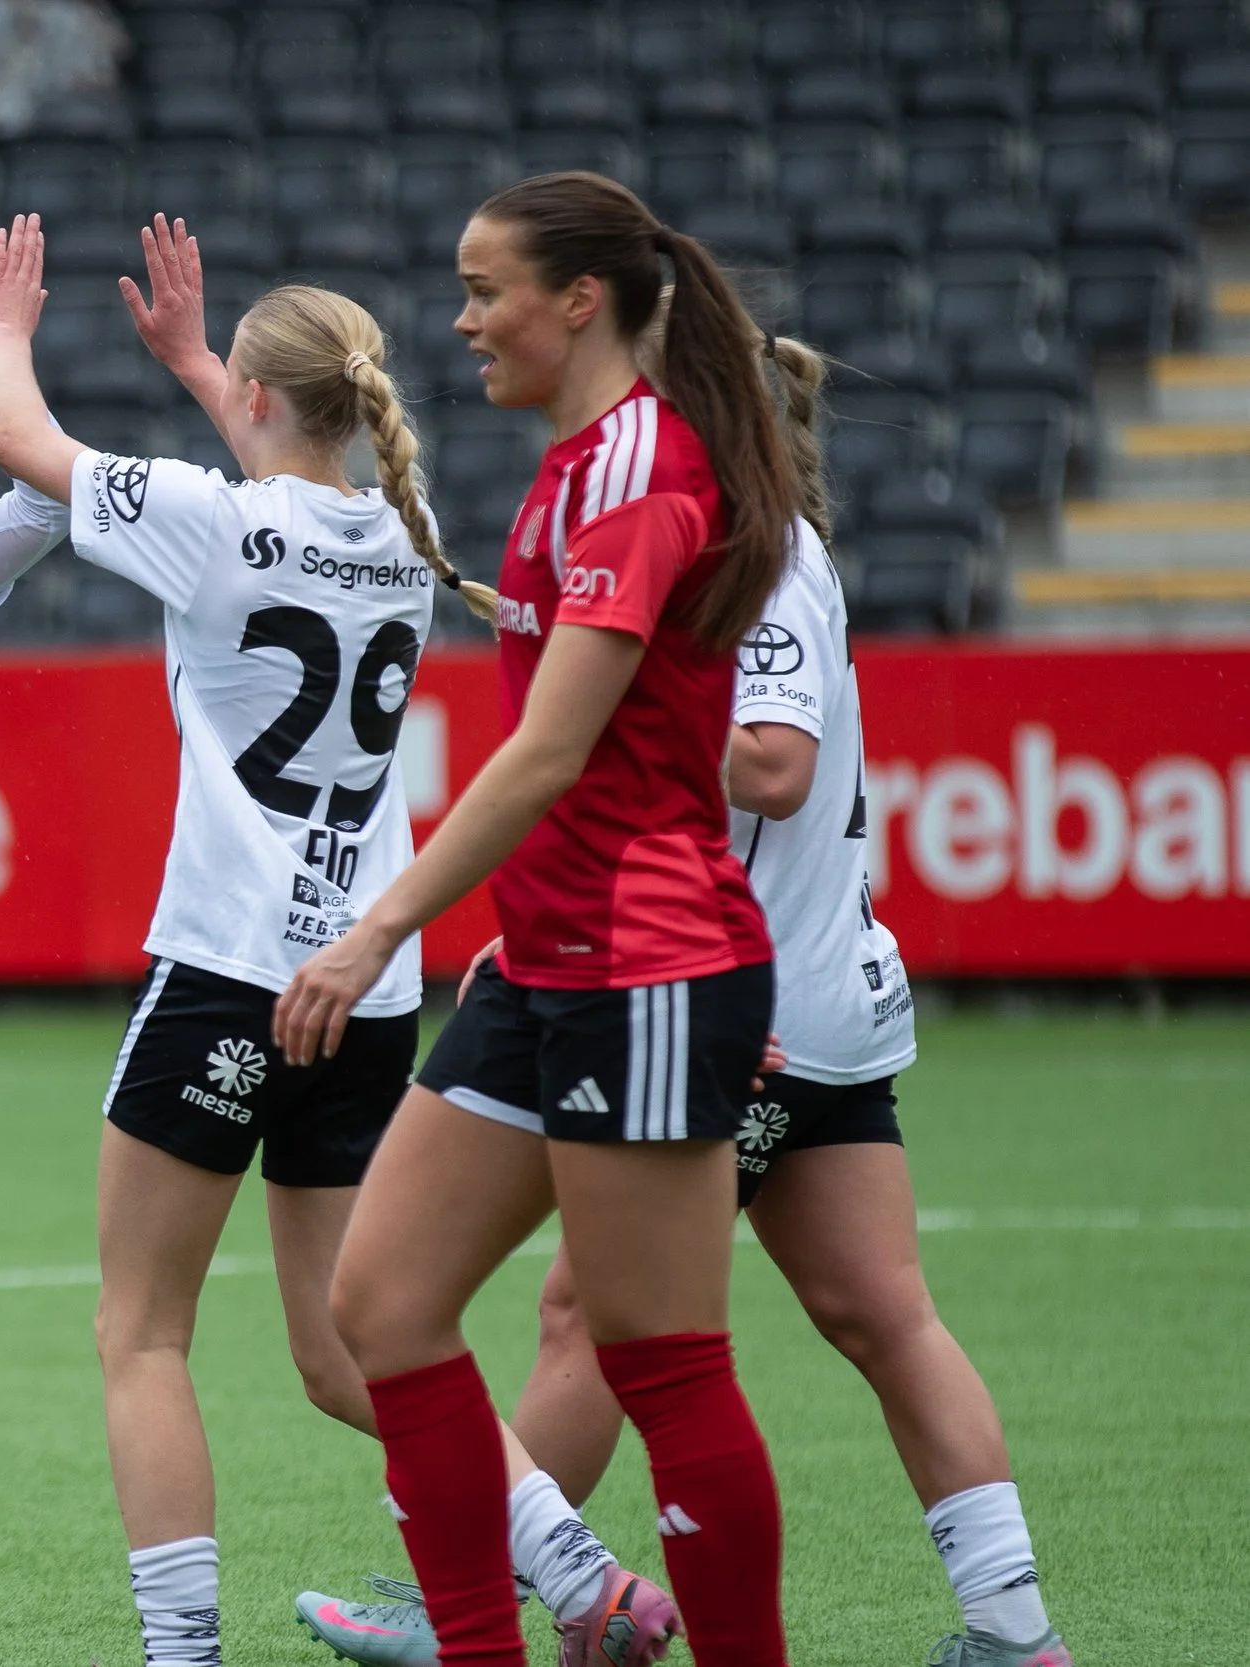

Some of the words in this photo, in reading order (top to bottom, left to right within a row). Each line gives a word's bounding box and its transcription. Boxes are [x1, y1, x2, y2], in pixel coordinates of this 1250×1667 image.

[300, 545, 434, 590] Sognekra
[777, 683, 817, 708] Sogn
[231, 605, 421, 833] 29
[180, 1083, 253, 1125] mesta
